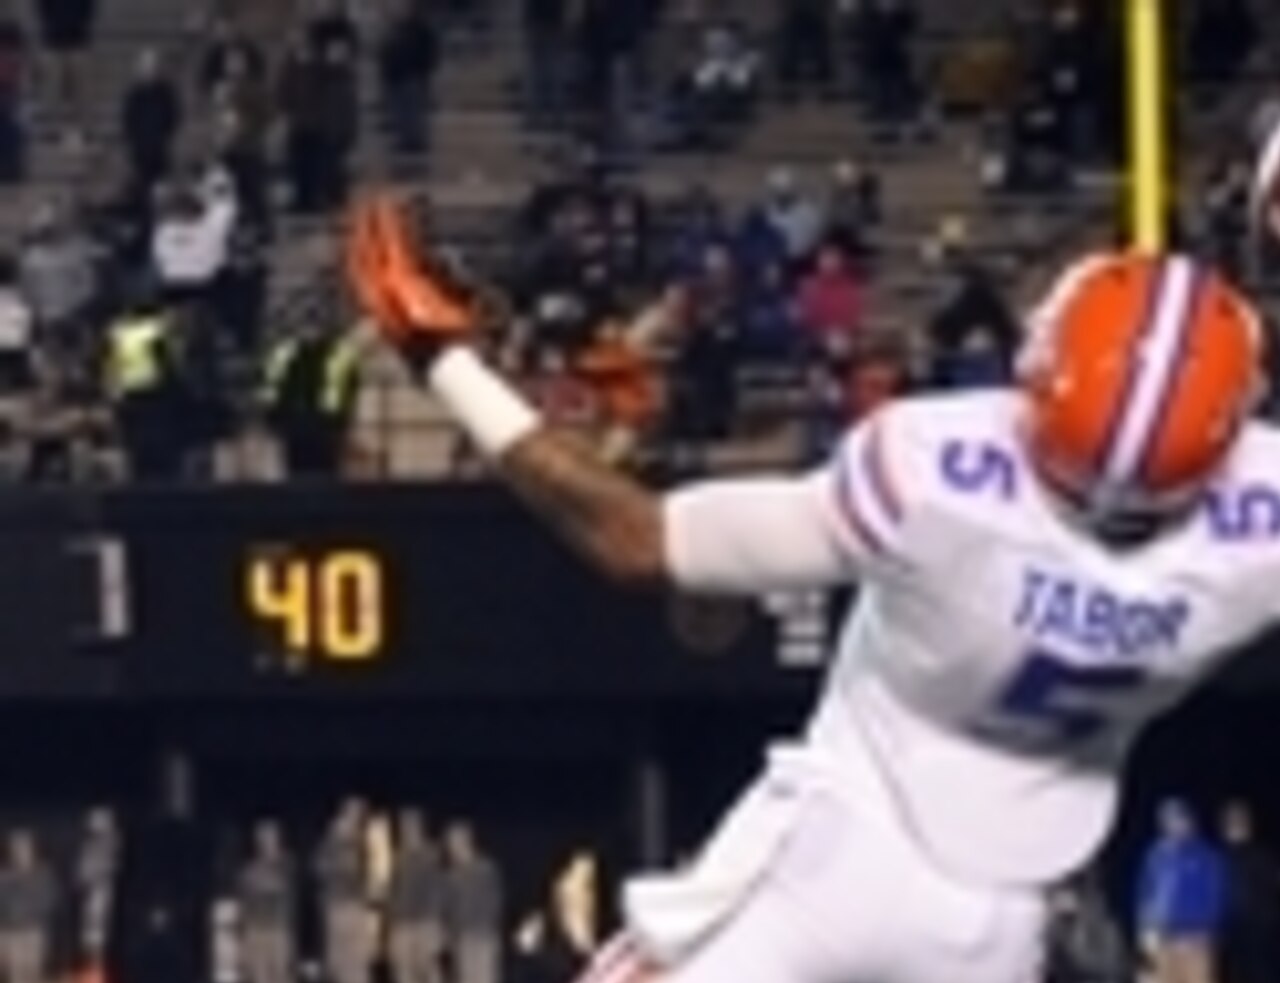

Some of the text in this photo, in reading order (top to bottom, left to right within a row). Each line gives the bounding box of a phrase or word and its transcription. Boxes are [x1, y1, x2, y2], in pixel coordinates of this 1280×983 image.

[938, 440, 1018, 499] 5
[249, 551, 382, 657] 40
[1014, 566, 1190, 654] TABOR
